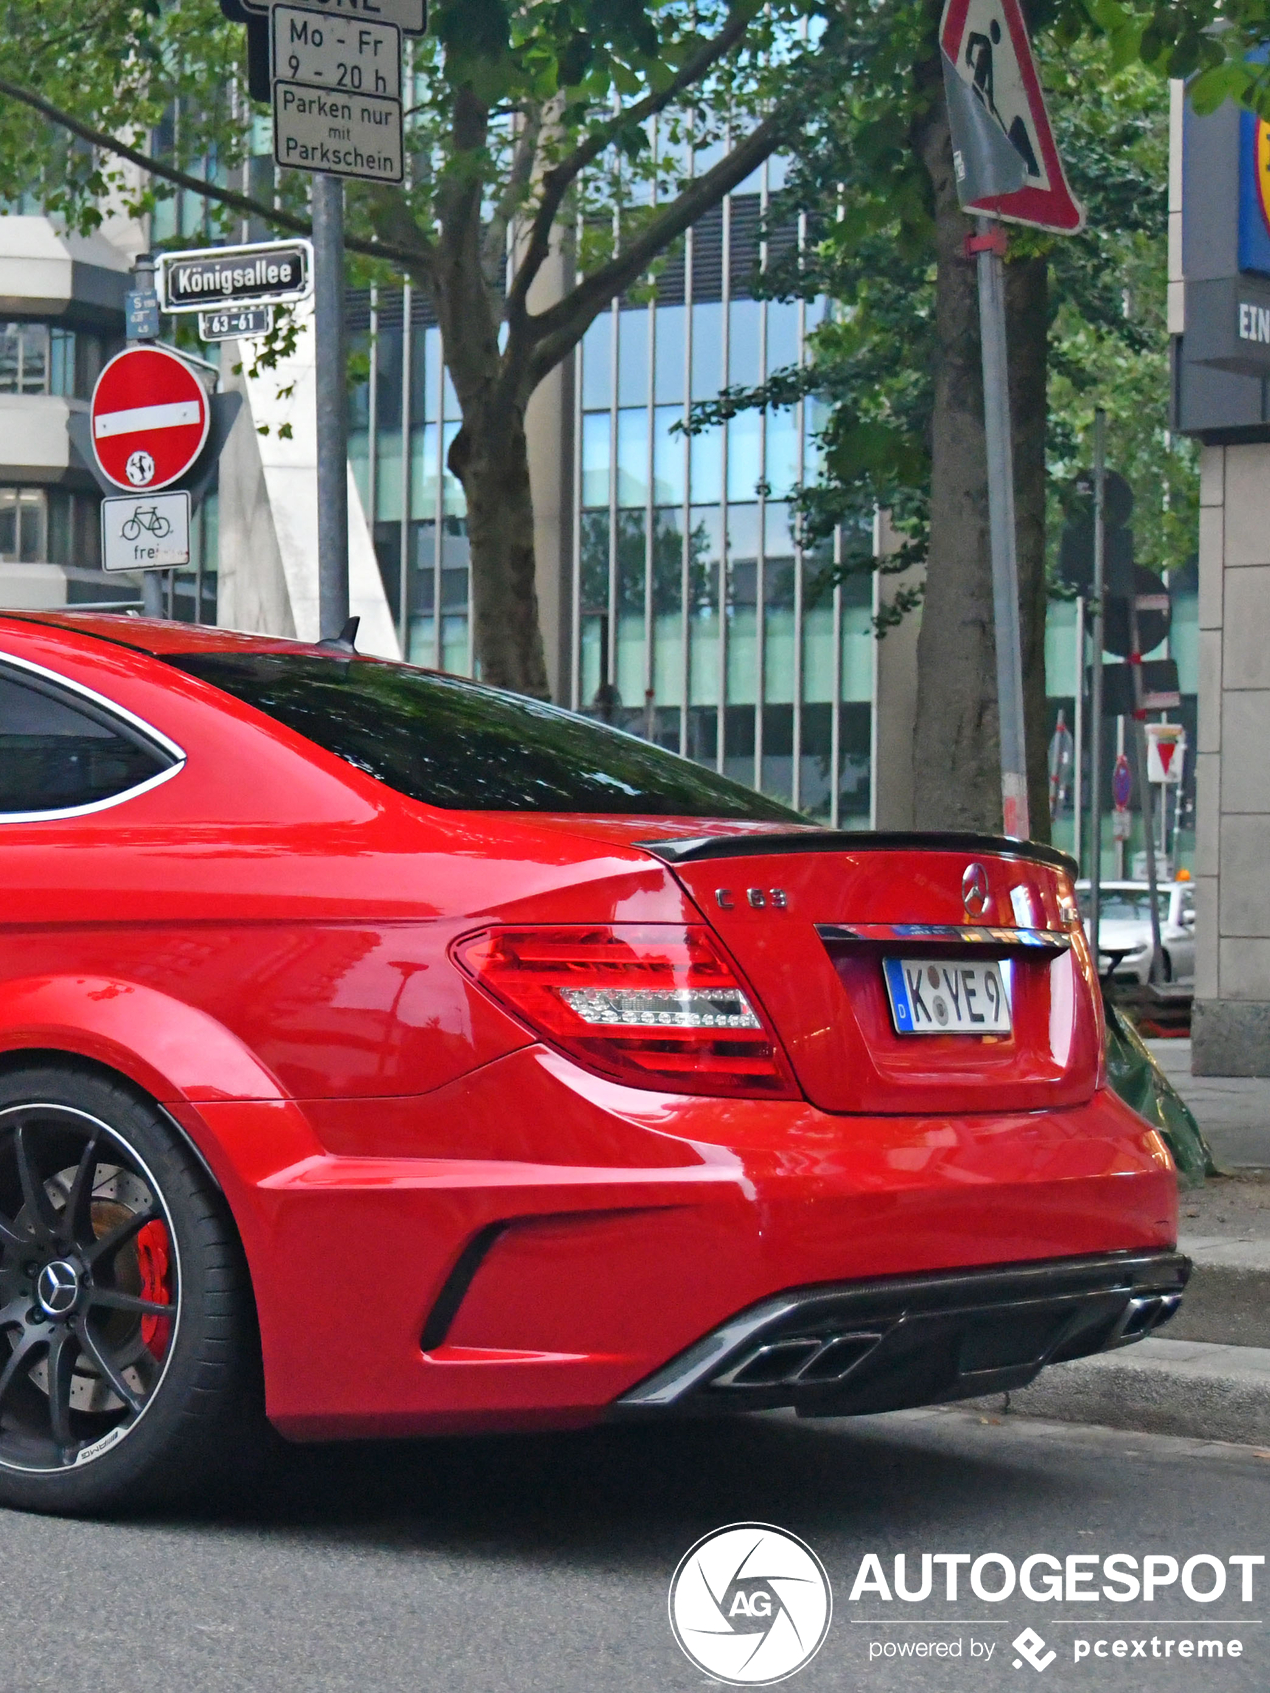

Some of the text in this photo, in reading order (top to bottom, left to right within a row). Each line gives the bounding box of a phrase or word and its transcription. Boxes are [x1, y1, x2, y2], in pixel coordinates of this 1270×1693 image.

[290, 18, 324, 48] Mo
[358, 30, 383, 57] Fr
[288, 55, 300, 79] 9
[336, 63, 362, 89] 20
[375, 69, 387, 93] h
[283, 90, 393, 126] Parken nur
[329, 126, 351, 142] mit
[286, 137, 393, 172] Parkschein
[179, 260, 292, 294] Königsallee
[715, 888, 788, 908] C 63
[897, 1003, 907, 1019] D
[906, 968, 932, 1022] K
